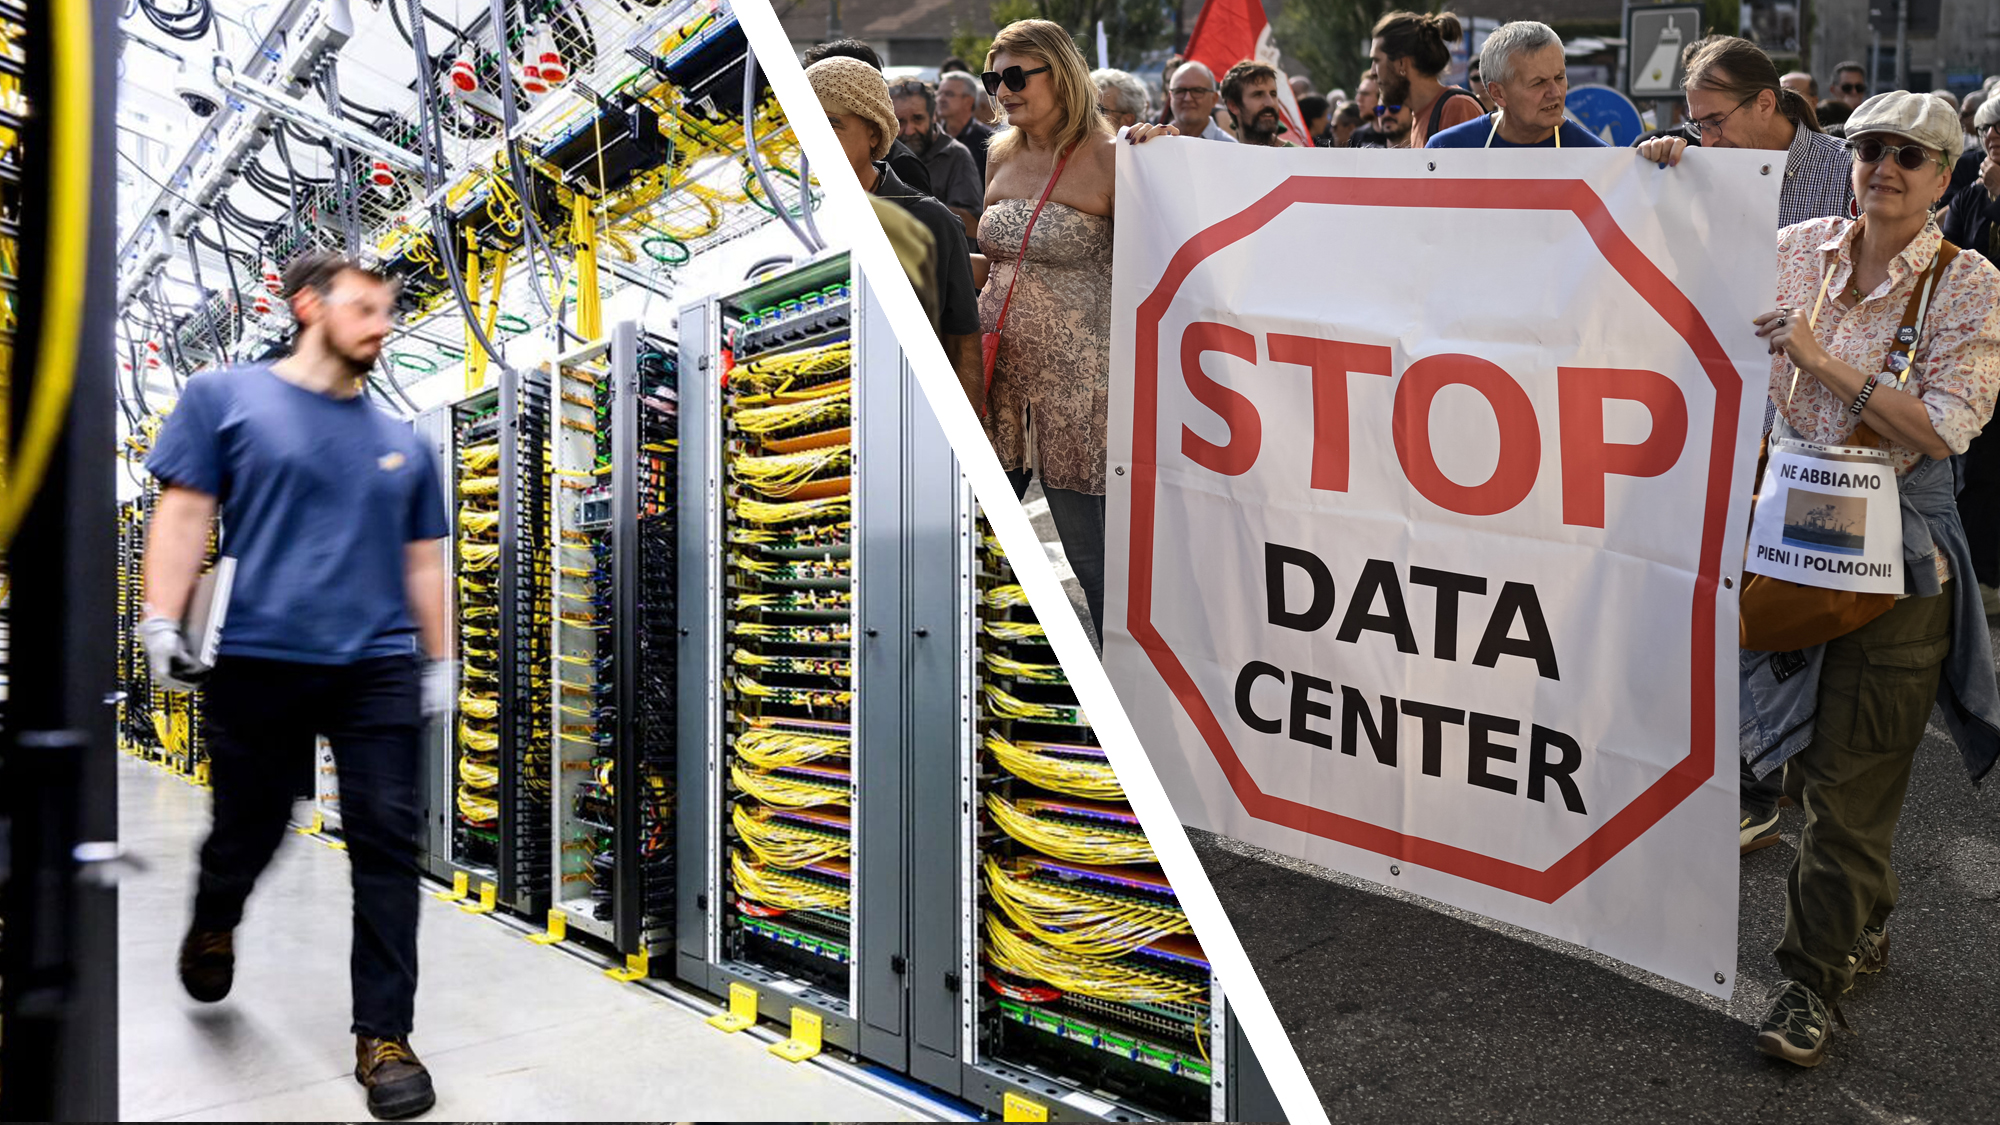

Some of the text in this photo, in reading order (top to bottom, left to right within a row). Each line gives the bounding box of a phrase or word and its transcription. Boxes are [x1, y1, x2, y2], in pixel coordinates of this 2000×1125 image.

[1180, 321, 1688, 529] STOP
[1780, 463, 1881, 490] NE ABBIAMO
[1264, 541, 1561, 681] DATA
[1757, 544, 1892, 578] PIENI I POLMONI!
[1234, 660, 1588, 816] CENTER
